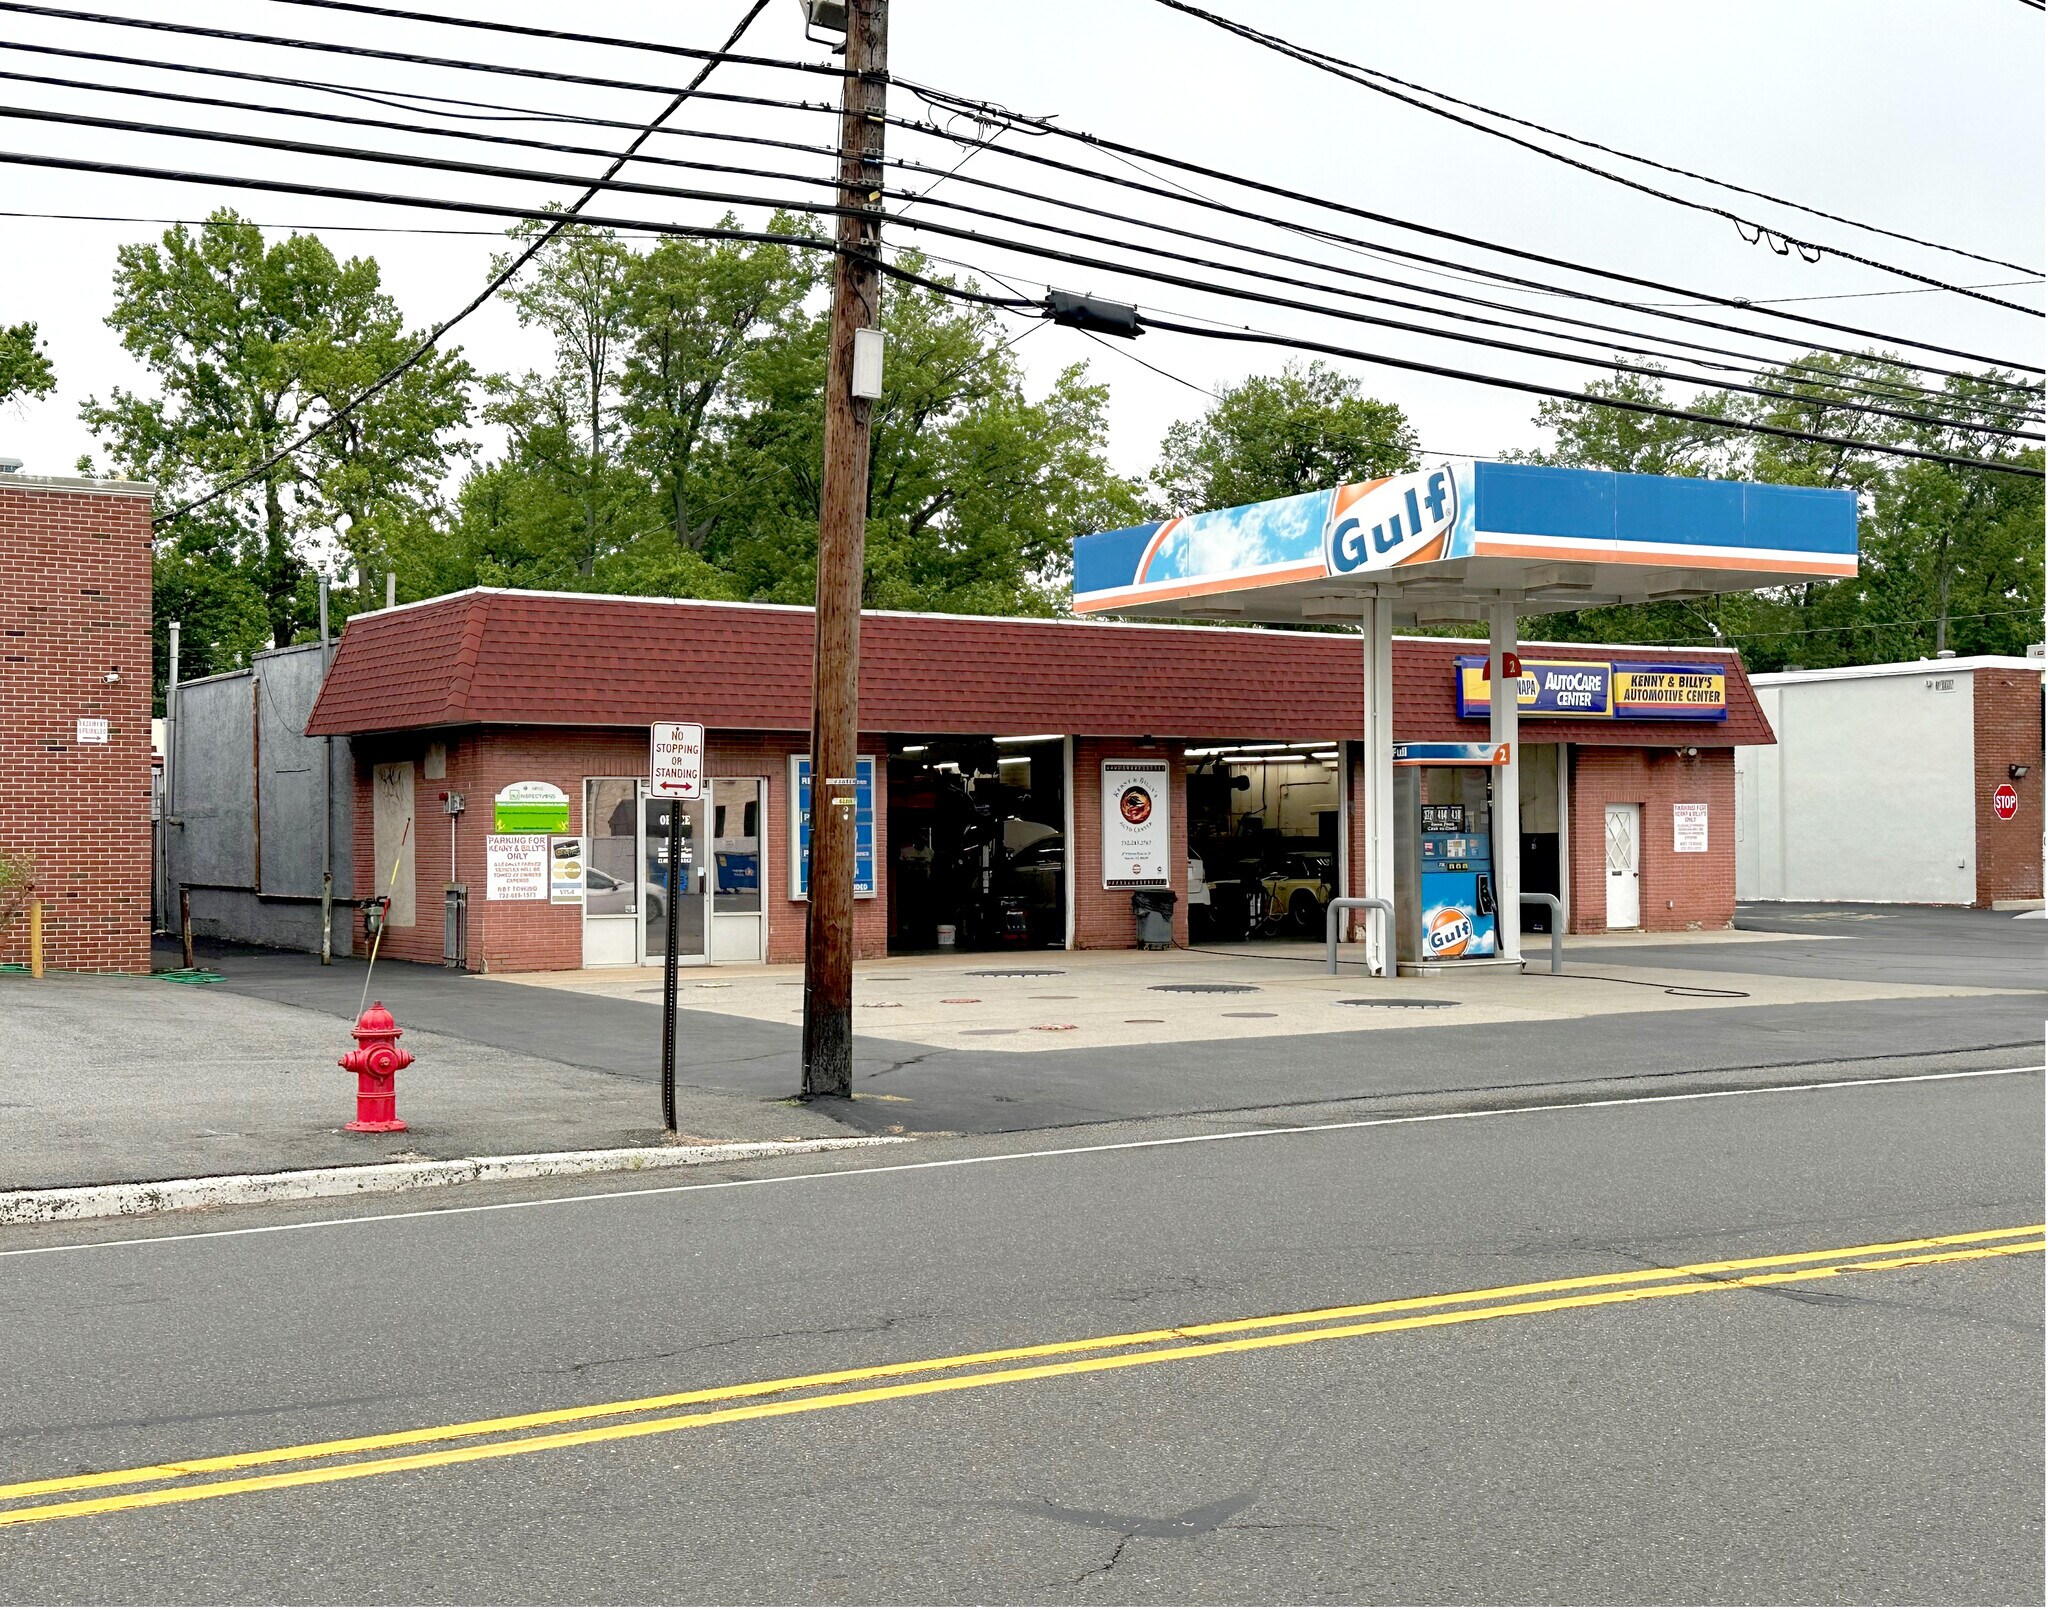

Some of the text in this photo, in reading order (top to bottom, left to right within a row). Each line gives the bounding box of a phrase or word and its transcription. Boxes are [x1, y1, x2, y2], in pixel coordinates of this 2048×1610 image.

[1332, 472, 1446, 572] Gulf
[1509, 660, 1516, 672] 2
[1517, 680, 1536, 695] NAPA
[1631, 675, 1713, 688] KENNY & BILLY'S
[1556, 691, 1592, 707] CENTER
[1624, 688, 1721, 703] AUTOMOTIVE CENTER
[671, 730, 684, 741] NO
[656, 743, 699, 755] STOPPING
[1500, 748, 1507, 761] 2
[671, 757, 682, 766] OR
[655, 767, 698, 779] STANDING
[1995, 796, 2016, 808] STOP
[488, 836, 546, 844] PARKING FOR
[507, 852, 528, 860] ONLY
[1431, 921, 1470, 948] Gulf
